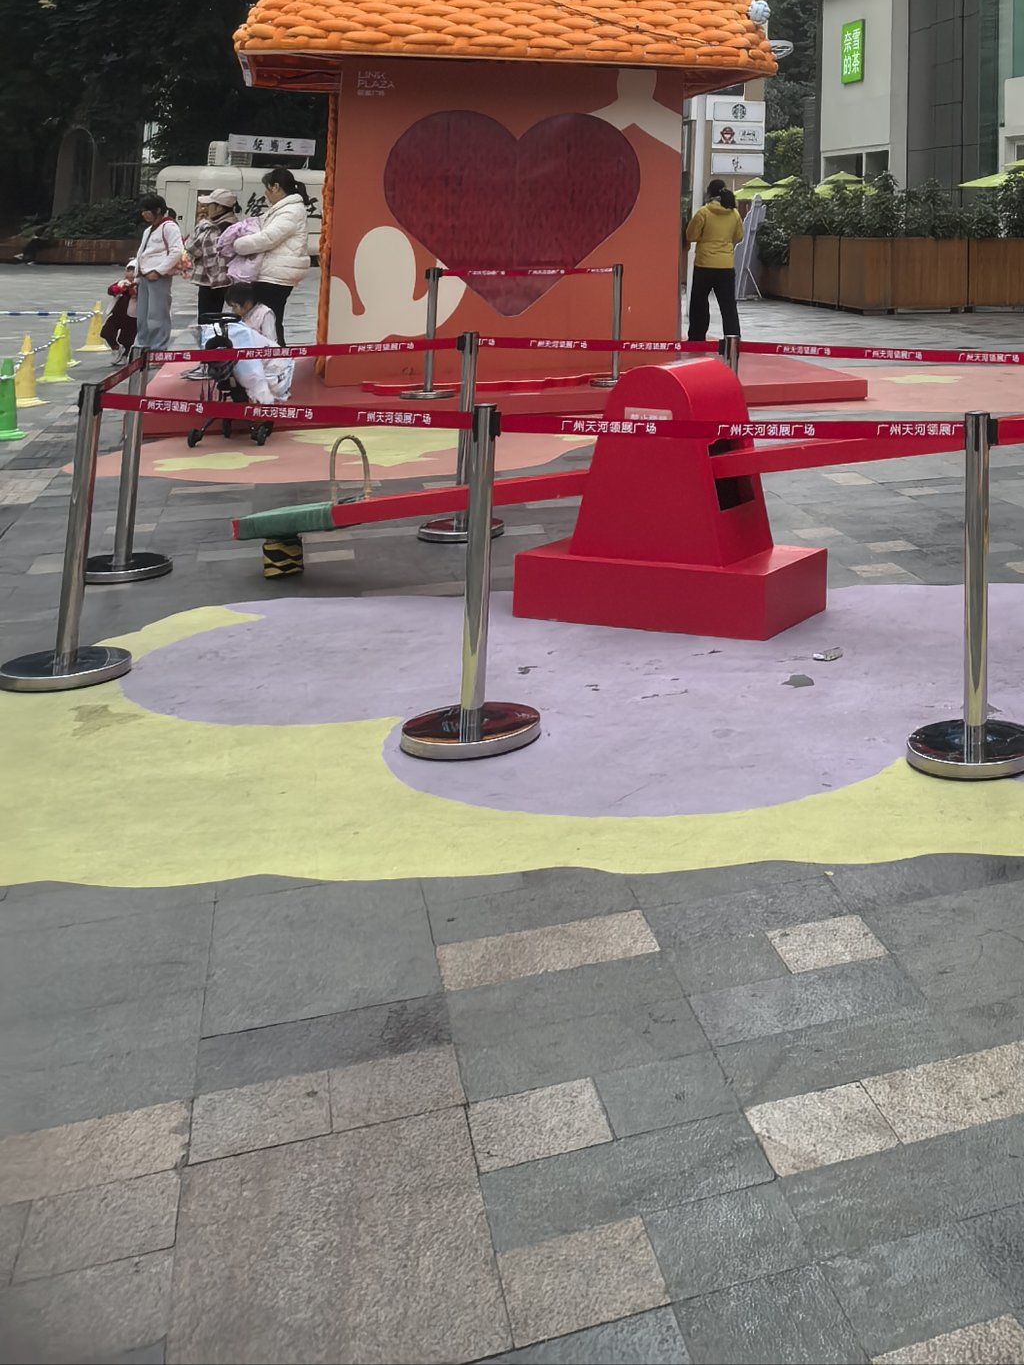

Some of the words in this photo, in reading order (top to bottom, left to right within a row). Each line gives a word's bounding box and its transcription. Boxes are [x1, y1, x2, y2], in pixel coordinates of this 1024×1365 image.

[244, 406, 313, 419] 广州天河领展广场
[357, 411, 431, 425] 广州天河领展广场
[561, 420, 656, 434] 广州天河领展广场
[718, 424, 815, 437] 广州天河领展广场
